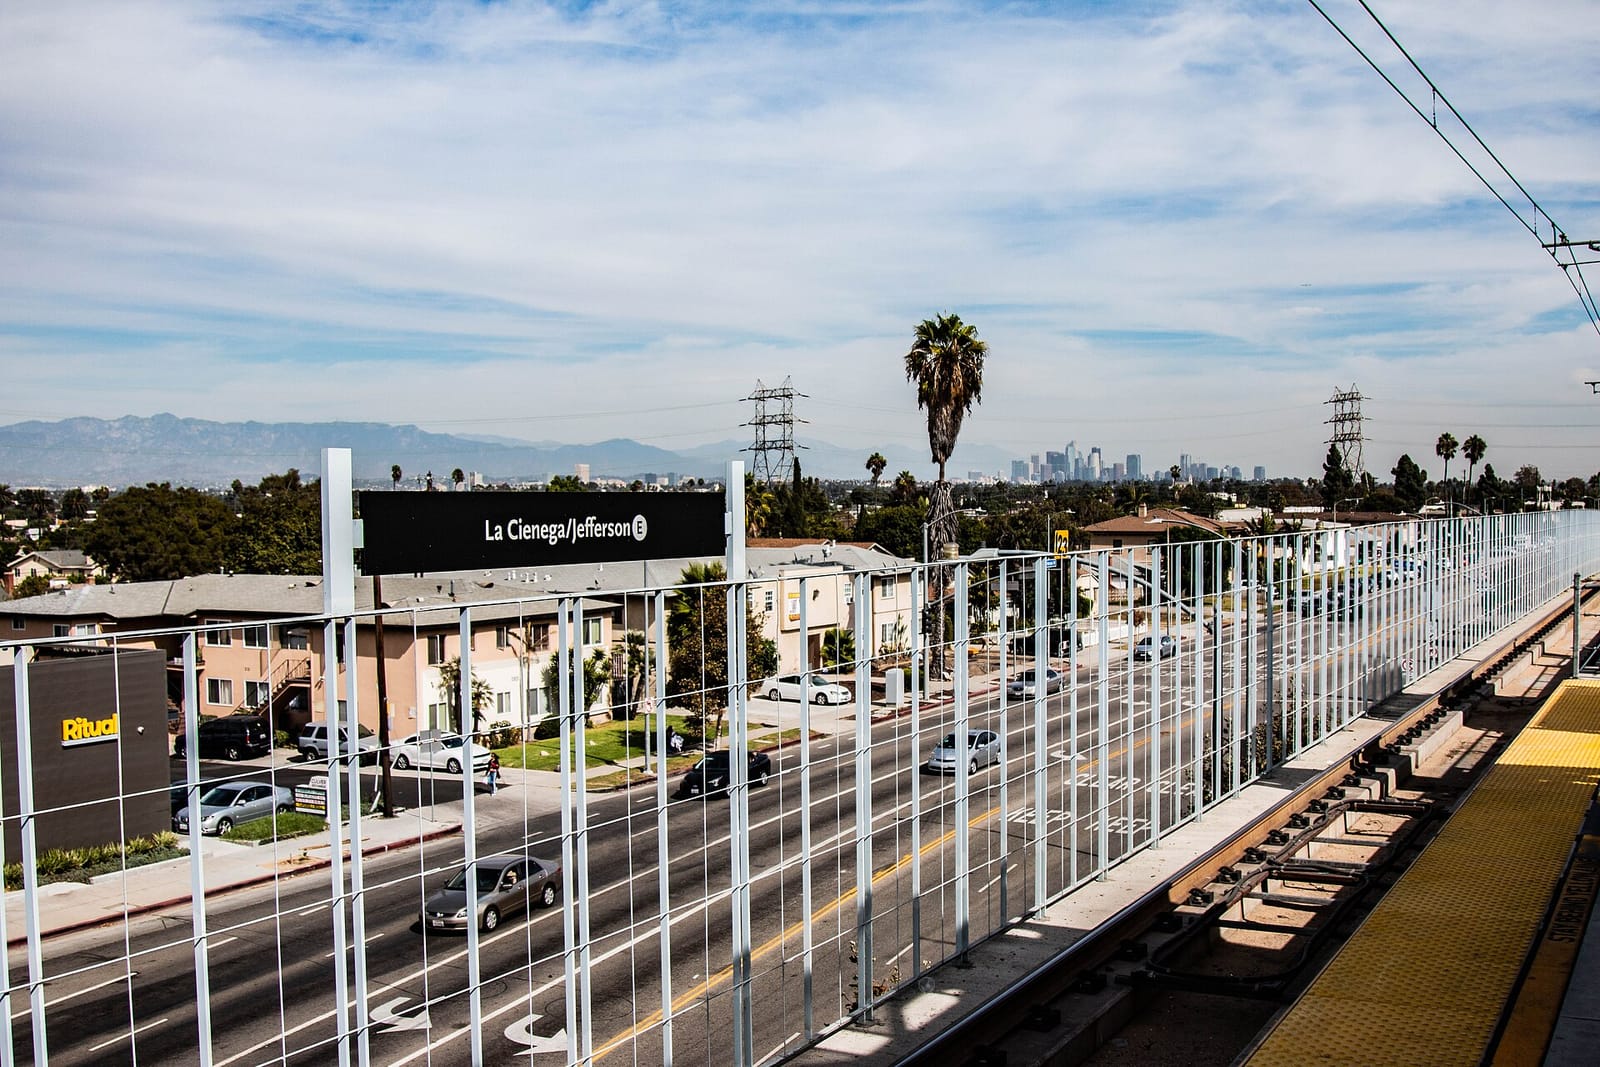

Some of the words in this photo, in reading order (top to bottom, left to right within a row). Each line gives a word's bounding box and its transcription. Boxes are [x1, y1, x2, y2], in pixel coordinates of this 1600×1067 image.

[485, 519, 503, 541] La
[507, 516, 631, 546] Cienega/Jefferson
[62, 713, 119, 741] Ritual
[1547, 923, 1577, 943] STAY
